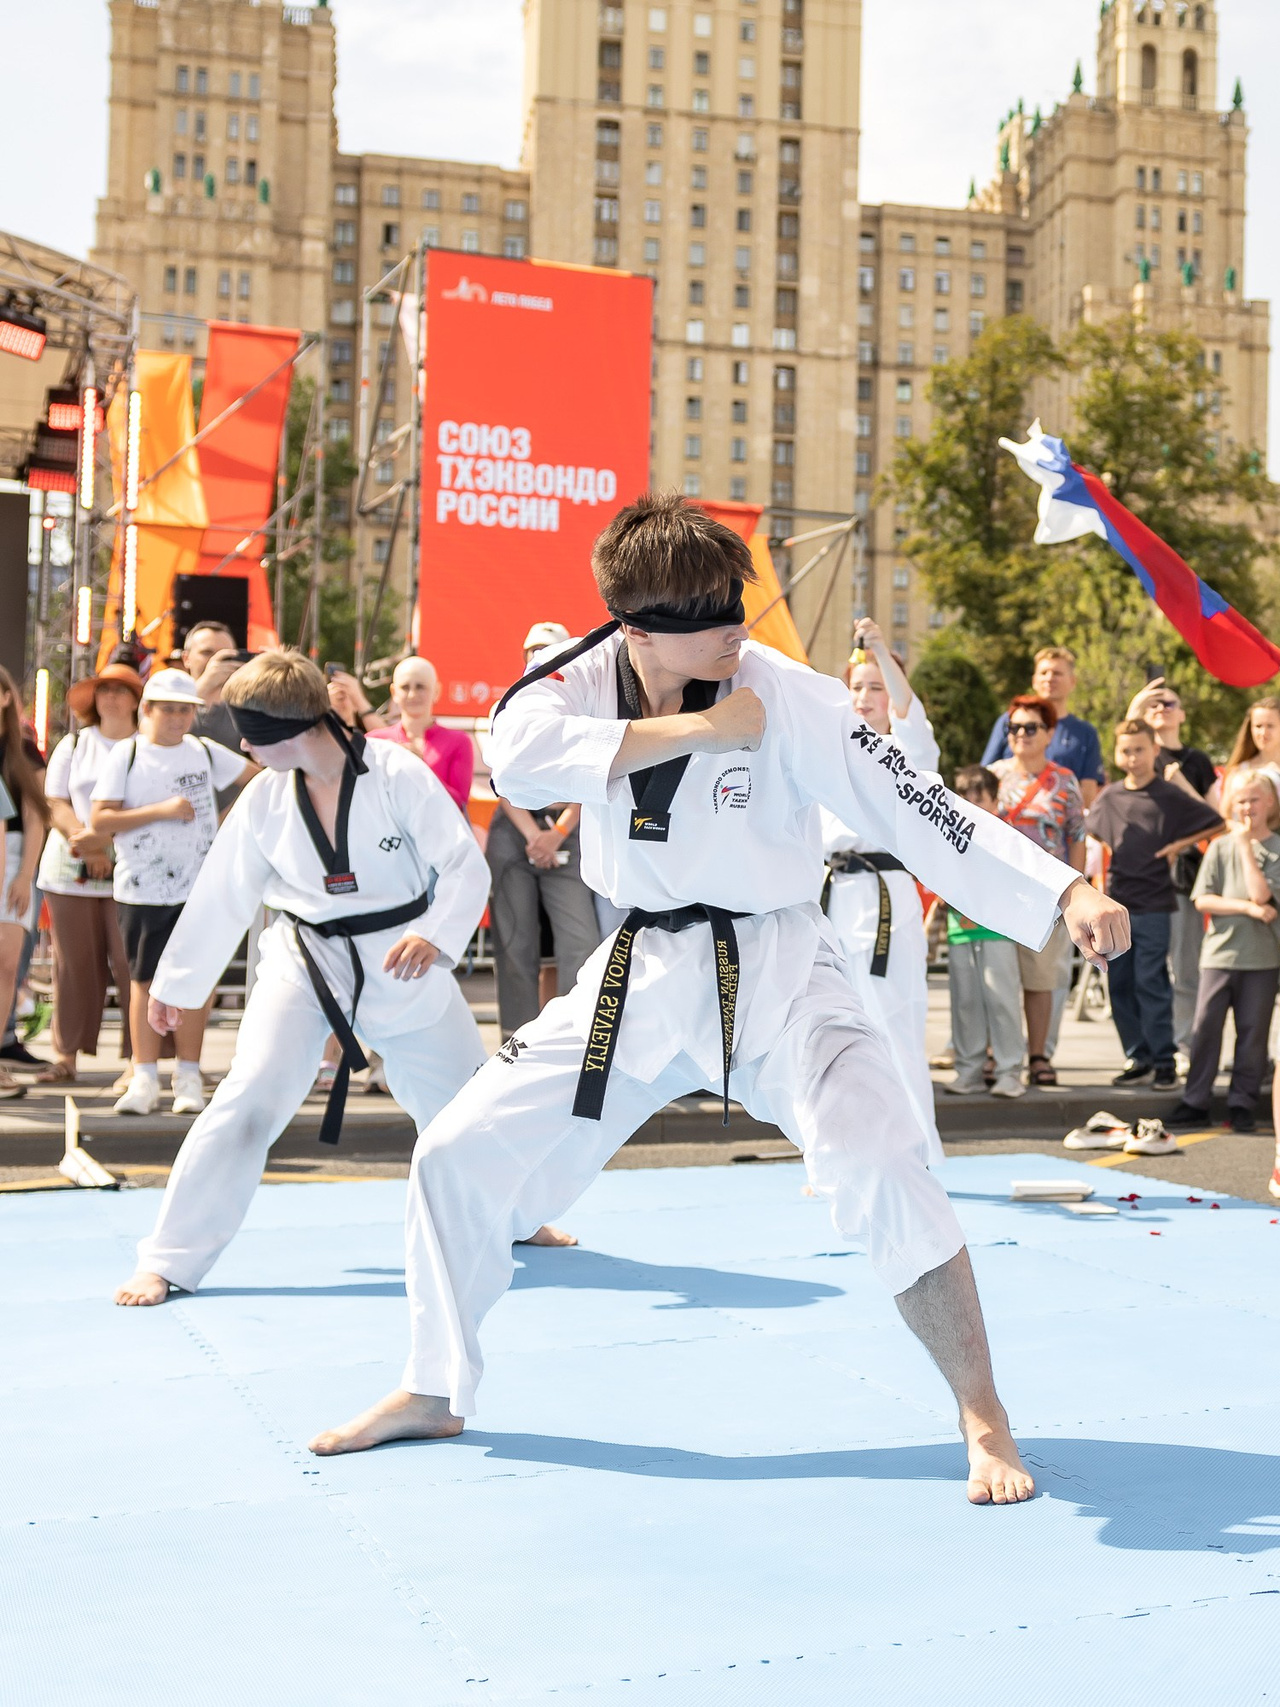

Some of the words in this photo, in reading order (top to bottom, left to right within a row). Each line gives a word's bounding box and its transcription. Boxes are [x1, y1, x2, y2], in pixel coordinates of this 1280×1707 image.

[438, 420, 532, 460] СОЮЗ
[437, 455, 617, 506] ТХЭКВОНДО
[436, 489, 560, 532] РОССИИ
